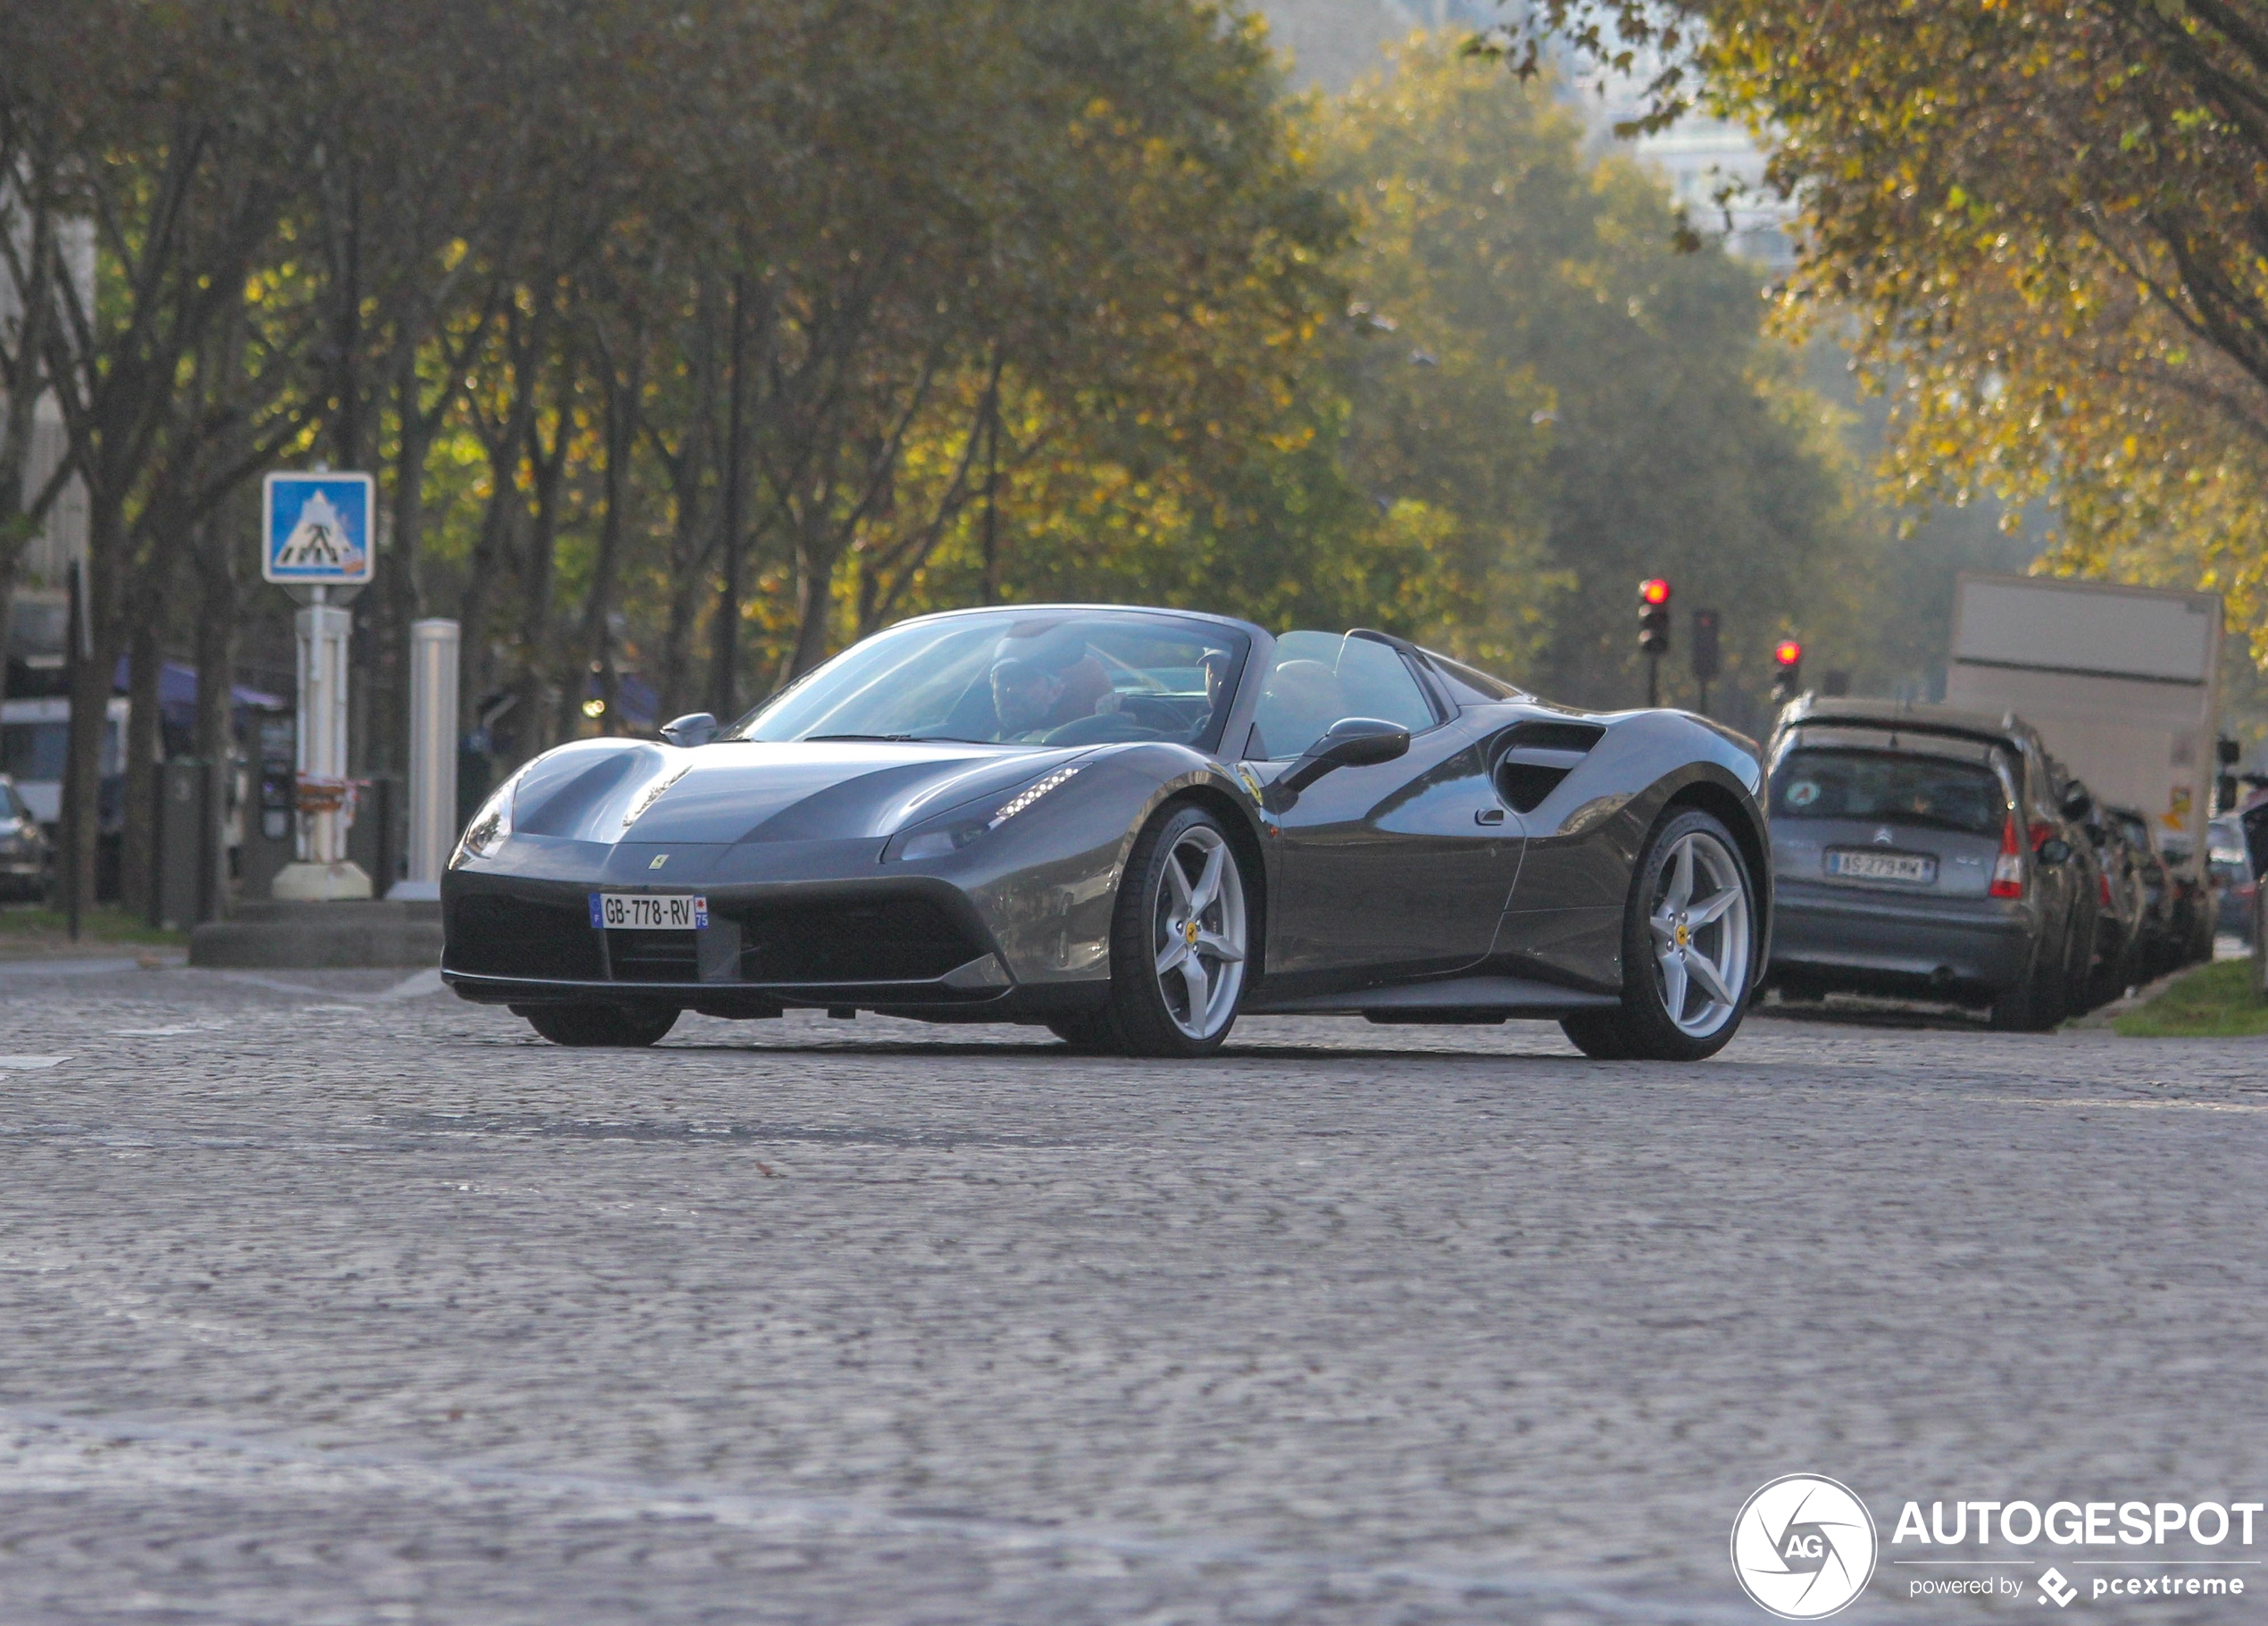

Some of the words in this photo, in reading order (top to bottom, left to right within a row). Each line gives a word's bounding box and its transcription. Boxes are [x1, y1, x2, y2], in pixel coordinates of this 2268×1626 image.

[594, 914, 600, 922] F
[605, 898, 689, 925] GB-778-RV
[696, 914, 708, 927] 75
